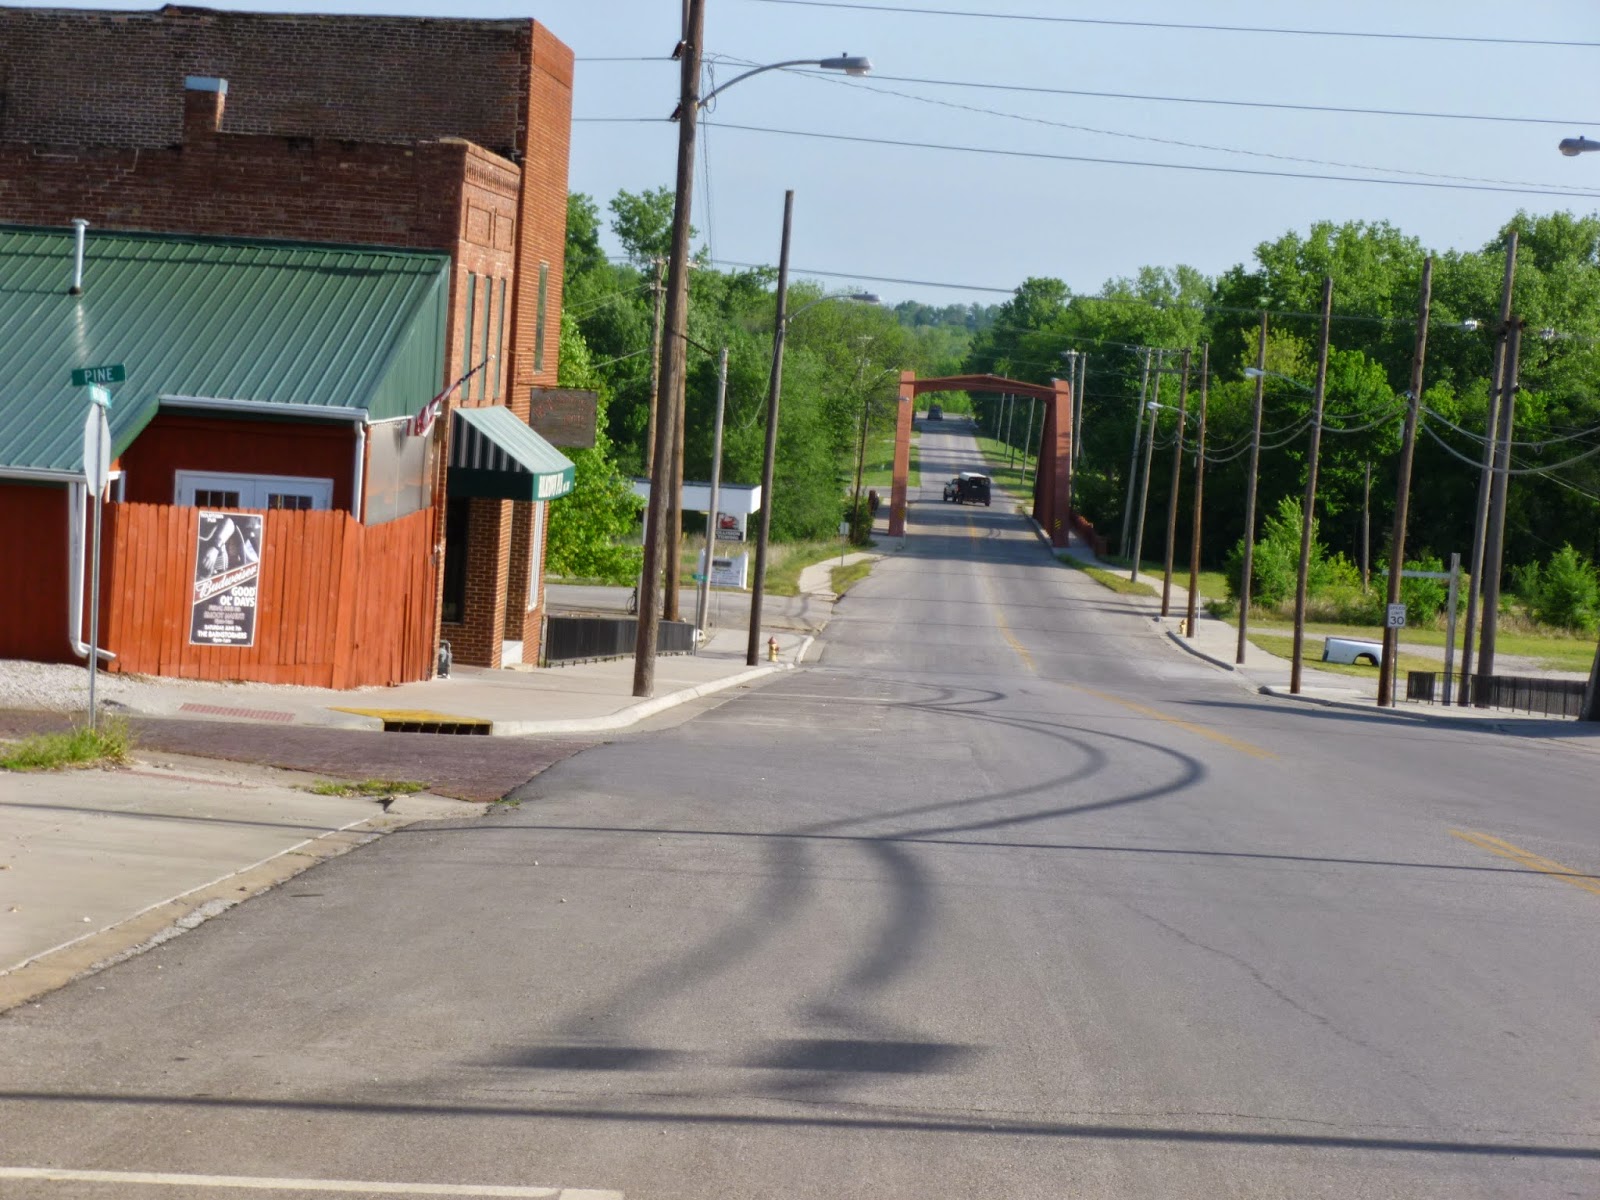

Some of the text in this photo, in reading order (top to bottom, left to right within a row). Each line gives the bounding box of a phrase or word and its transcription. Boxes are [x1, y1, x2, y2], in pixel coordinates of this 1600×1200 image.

[84, 368, 113, 383] PINE
[195, 565, 257, 599] Budweiser
[231, 586, 256, 597] GOOD
[233, 597, 256, 607] DAYS
[1390, 616, 1405, 625] 30
[197, 630, 208, 638] THE
